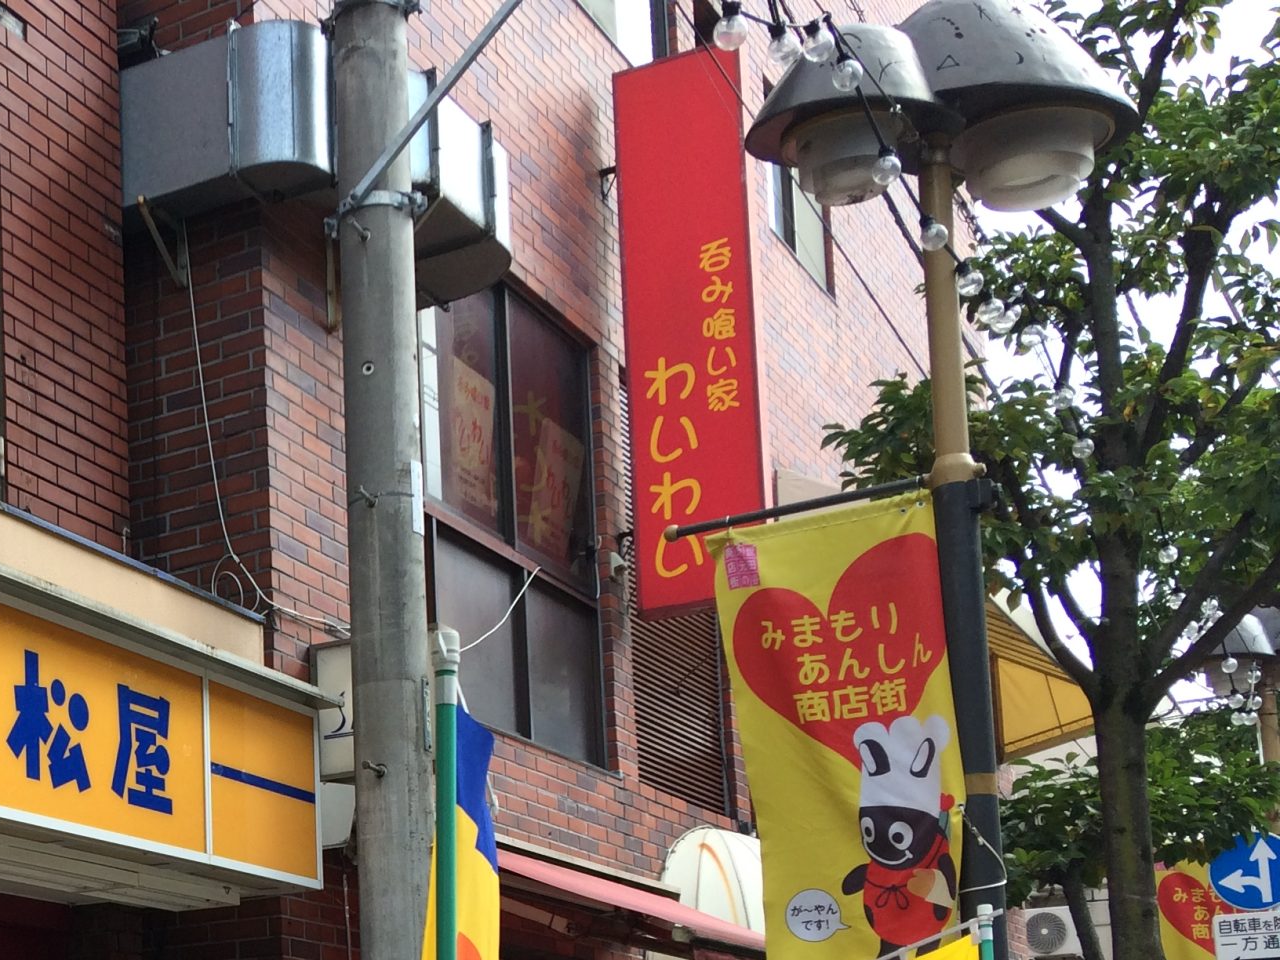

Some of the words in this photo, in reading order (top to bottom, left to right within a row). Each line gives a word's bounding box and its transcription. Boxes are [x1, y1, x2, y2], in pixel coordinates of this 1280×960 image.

[698, 237, 740, 412] 呑み喰い家
[643, 356, 705, 579] わいわい
[761, 601, 899, 651] みまもり
[797, 633, 933, 685] あんしん
[4, 647, 174, 816] 松屋
[793, 679, 908, 725] 商店街
